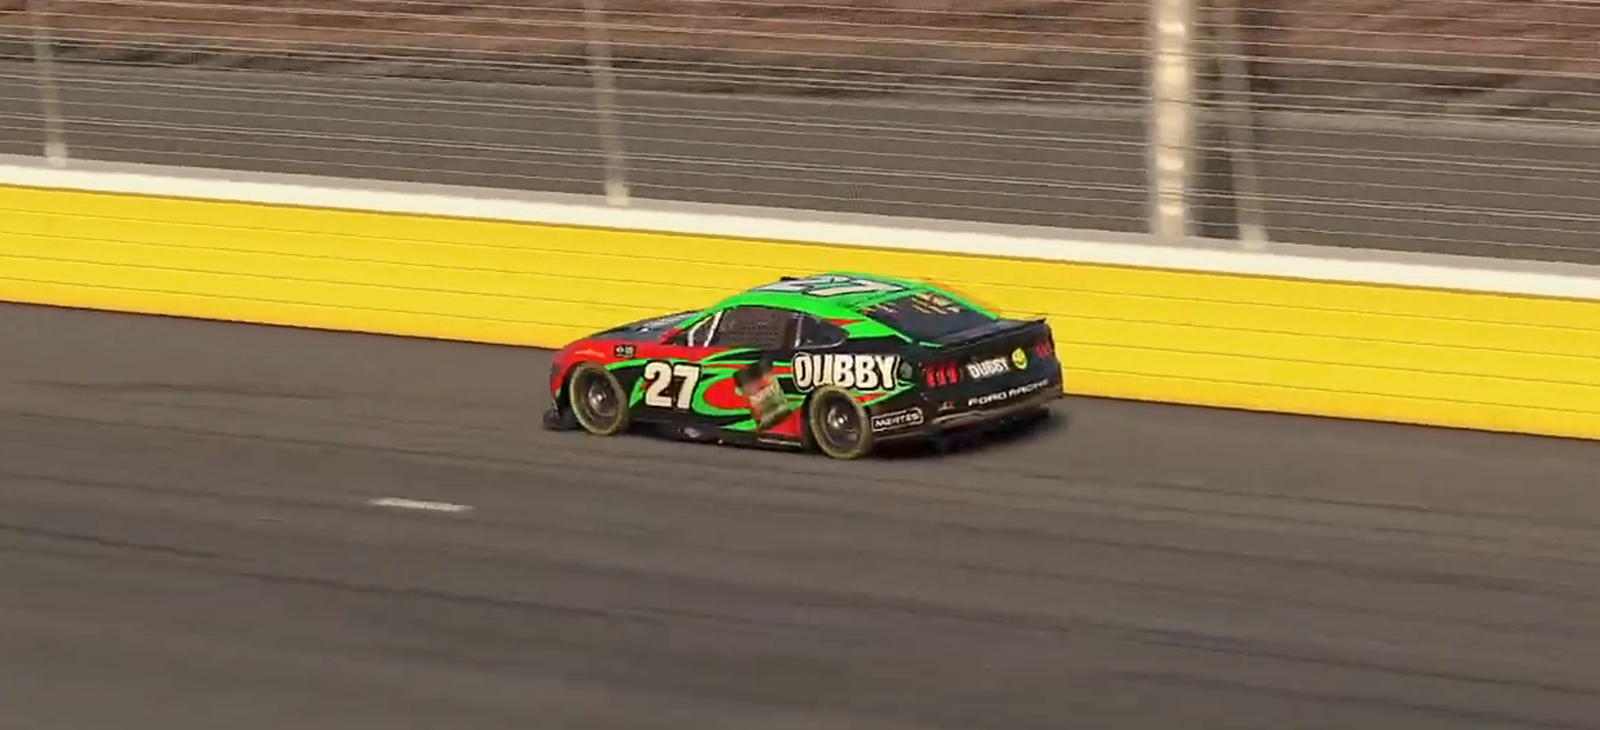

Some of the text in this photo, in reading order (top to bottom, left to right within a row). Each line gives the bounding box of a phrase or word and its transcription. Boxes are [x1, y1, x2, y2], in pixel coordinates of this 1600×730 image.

[750, 274, 906, 297] 27
[793, 354, 899, 390] DUBBY
[966, 357, 1010, 379] DUBBY
[644, 361, 700, 409] 27
[968, 391, 1008, 406] FORD
